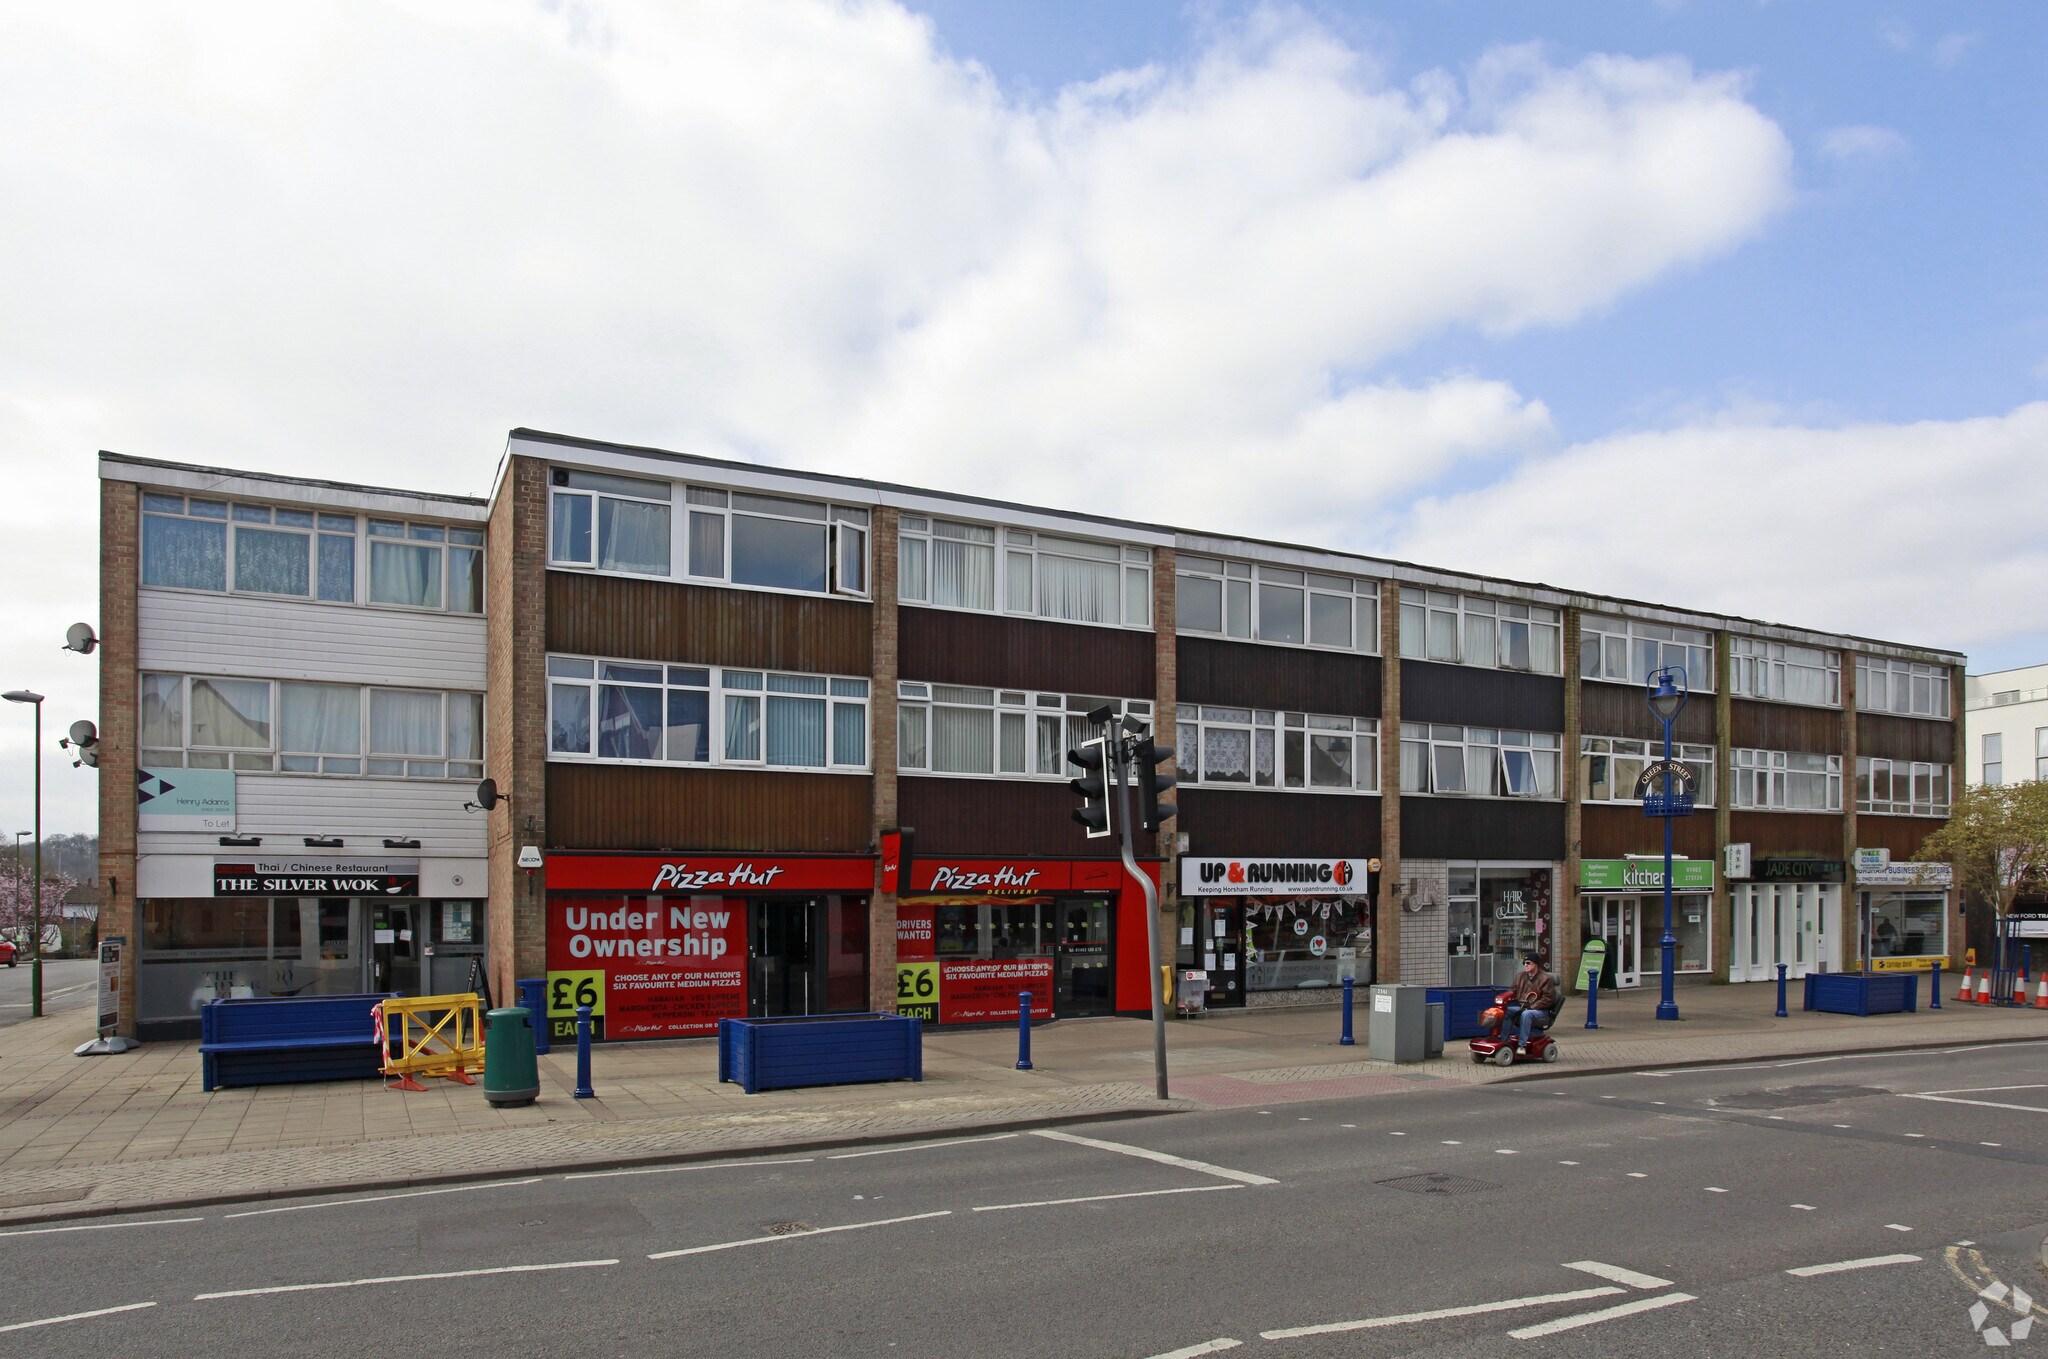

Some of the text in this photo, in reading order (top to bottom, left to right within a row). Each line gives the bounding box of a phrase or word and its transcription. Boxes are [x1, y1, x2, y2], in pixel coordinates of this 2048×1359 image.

[1642, 764, 1691, 784] QUEEN STREET
[176, 798, 200, 806] Henry
[258, 863, 280, 872] Thai
[291, 863, 332, 872] Chinese
[336, 864, 388, 872] Restaurant
[1200, 862, 1333, 883] UP & RUNNING
[1766, 863, 1791, 876] JADE
[1792, 863, 1813, 875] CITY
[652, 862, 784, 891] Pizza Hut
[930, 865, 1040, 891] Pizza Hut
[1623, 869, 1674, 884] kitchen
[217, 878, 379, 891] THE SILVER WOK
[1504, 891, 1522, 902] HAIR
[1496, 902, 1527, 919] LINE
[566, 906, 730, 931] Under New
[896, 920, 932, 929] DRIVERS
[897, 930, 931, 940] WANTED
[569, 932, 727, 960] Ownership
[898, 969, 933, 997] £6
[552, 977, 597, 1010] £6
[619, 1004, 667, 1012] MARGHERITA
[899, 1007, 931, 1019] EACH
